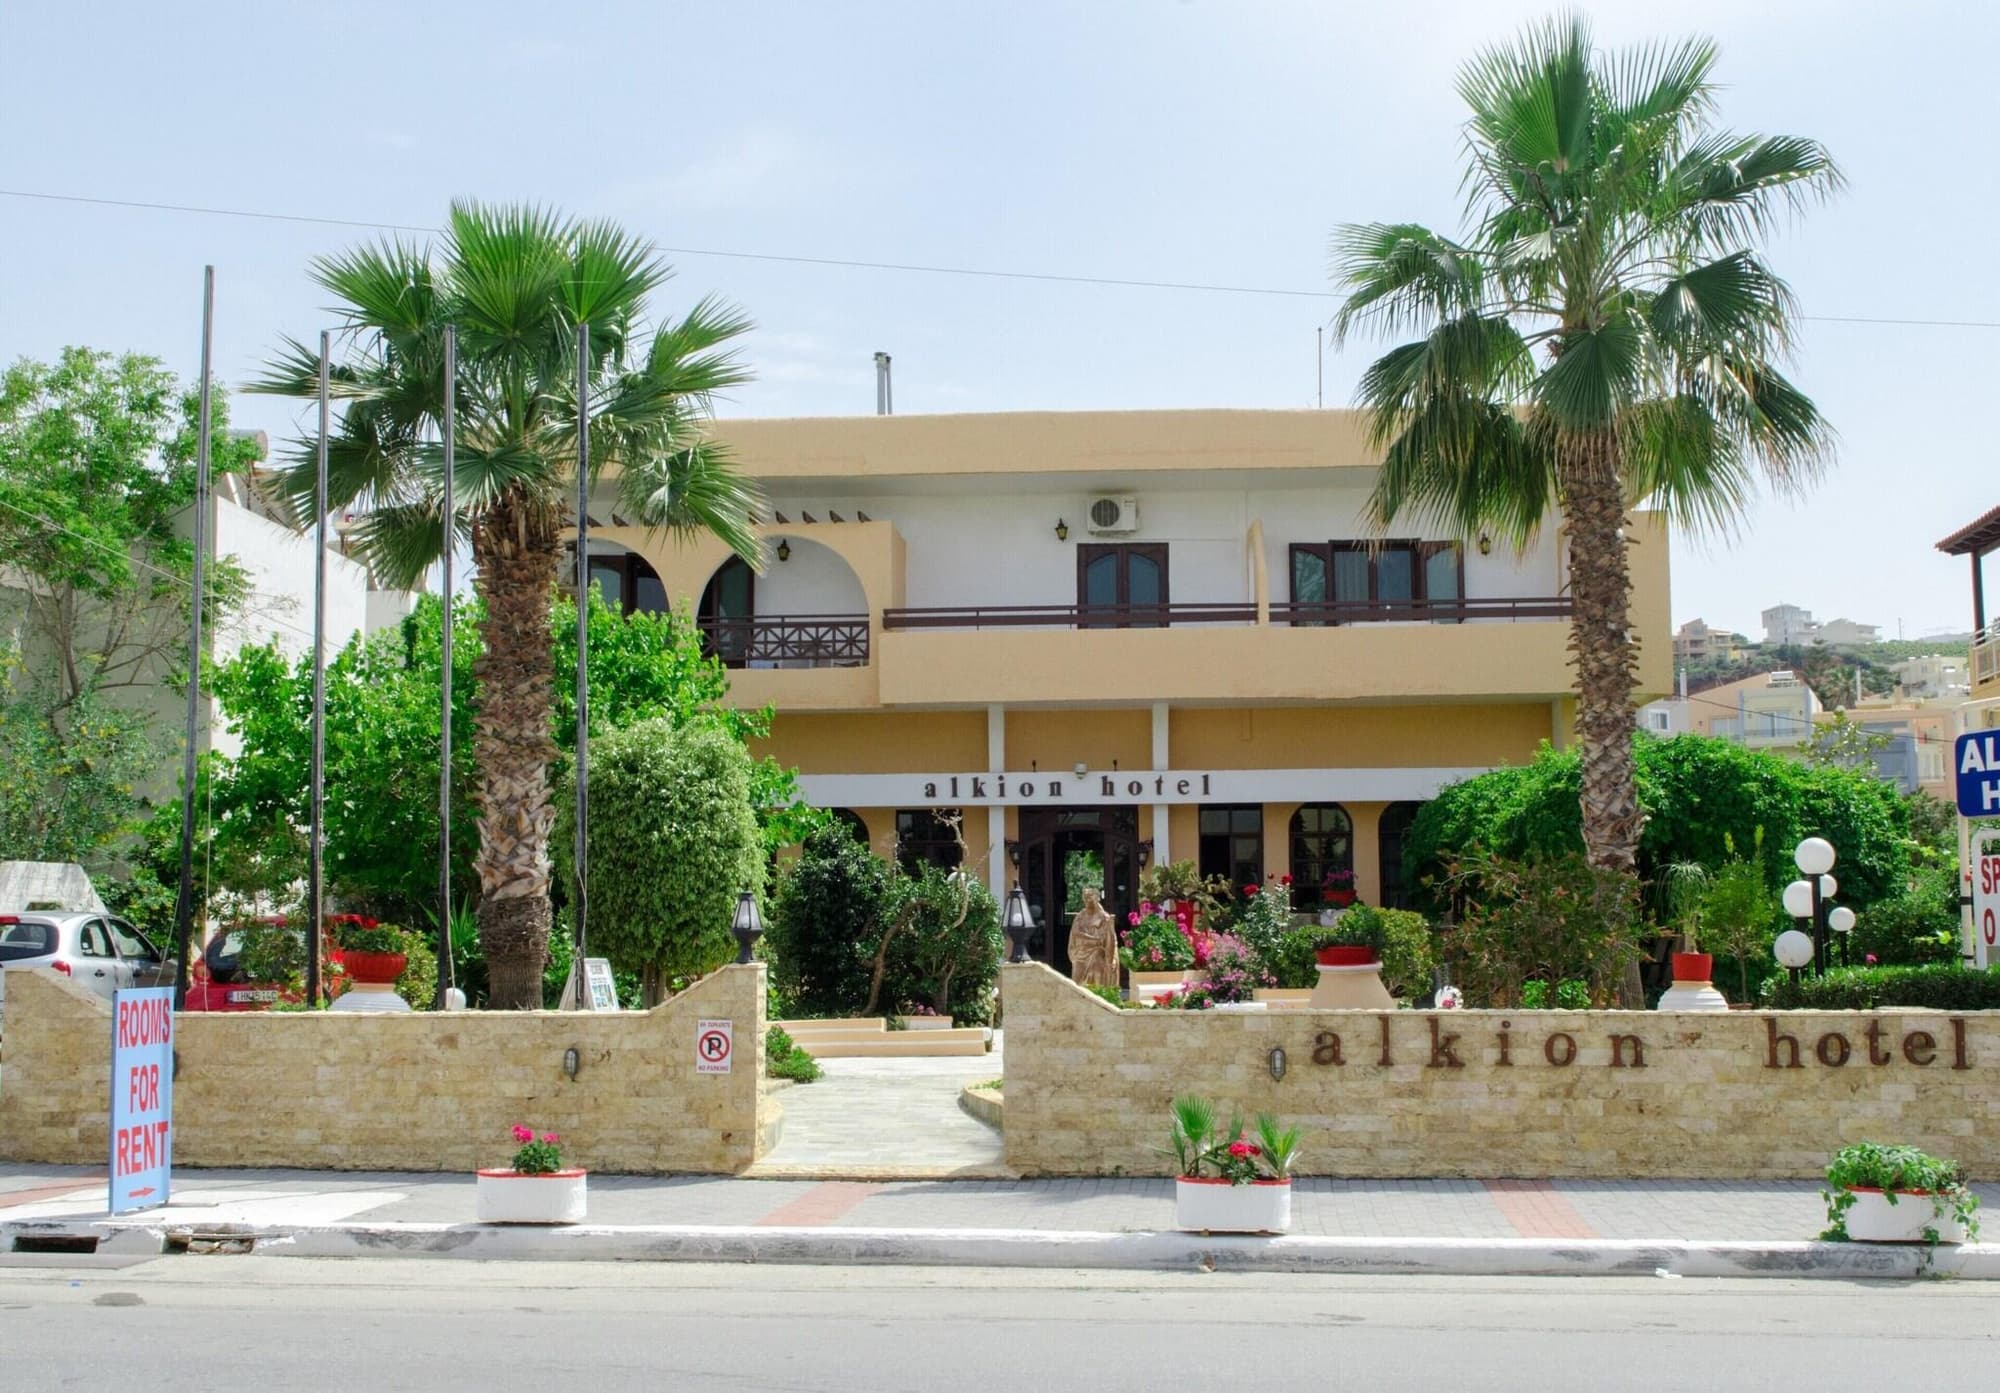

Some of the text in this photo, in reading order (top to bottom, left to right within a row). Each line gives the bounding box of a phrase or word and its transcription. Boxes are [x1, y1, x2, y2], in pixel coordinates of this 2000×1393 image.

[925, 774, 1210, 798] alkion hotel
[119, 998, 170, 1048] ROOMS
[1312, 1015, 1972, 1070] alkion hotel
[130, 1064, 159, 1114] FOR
[117, 1121, 168, 1176] RENT
